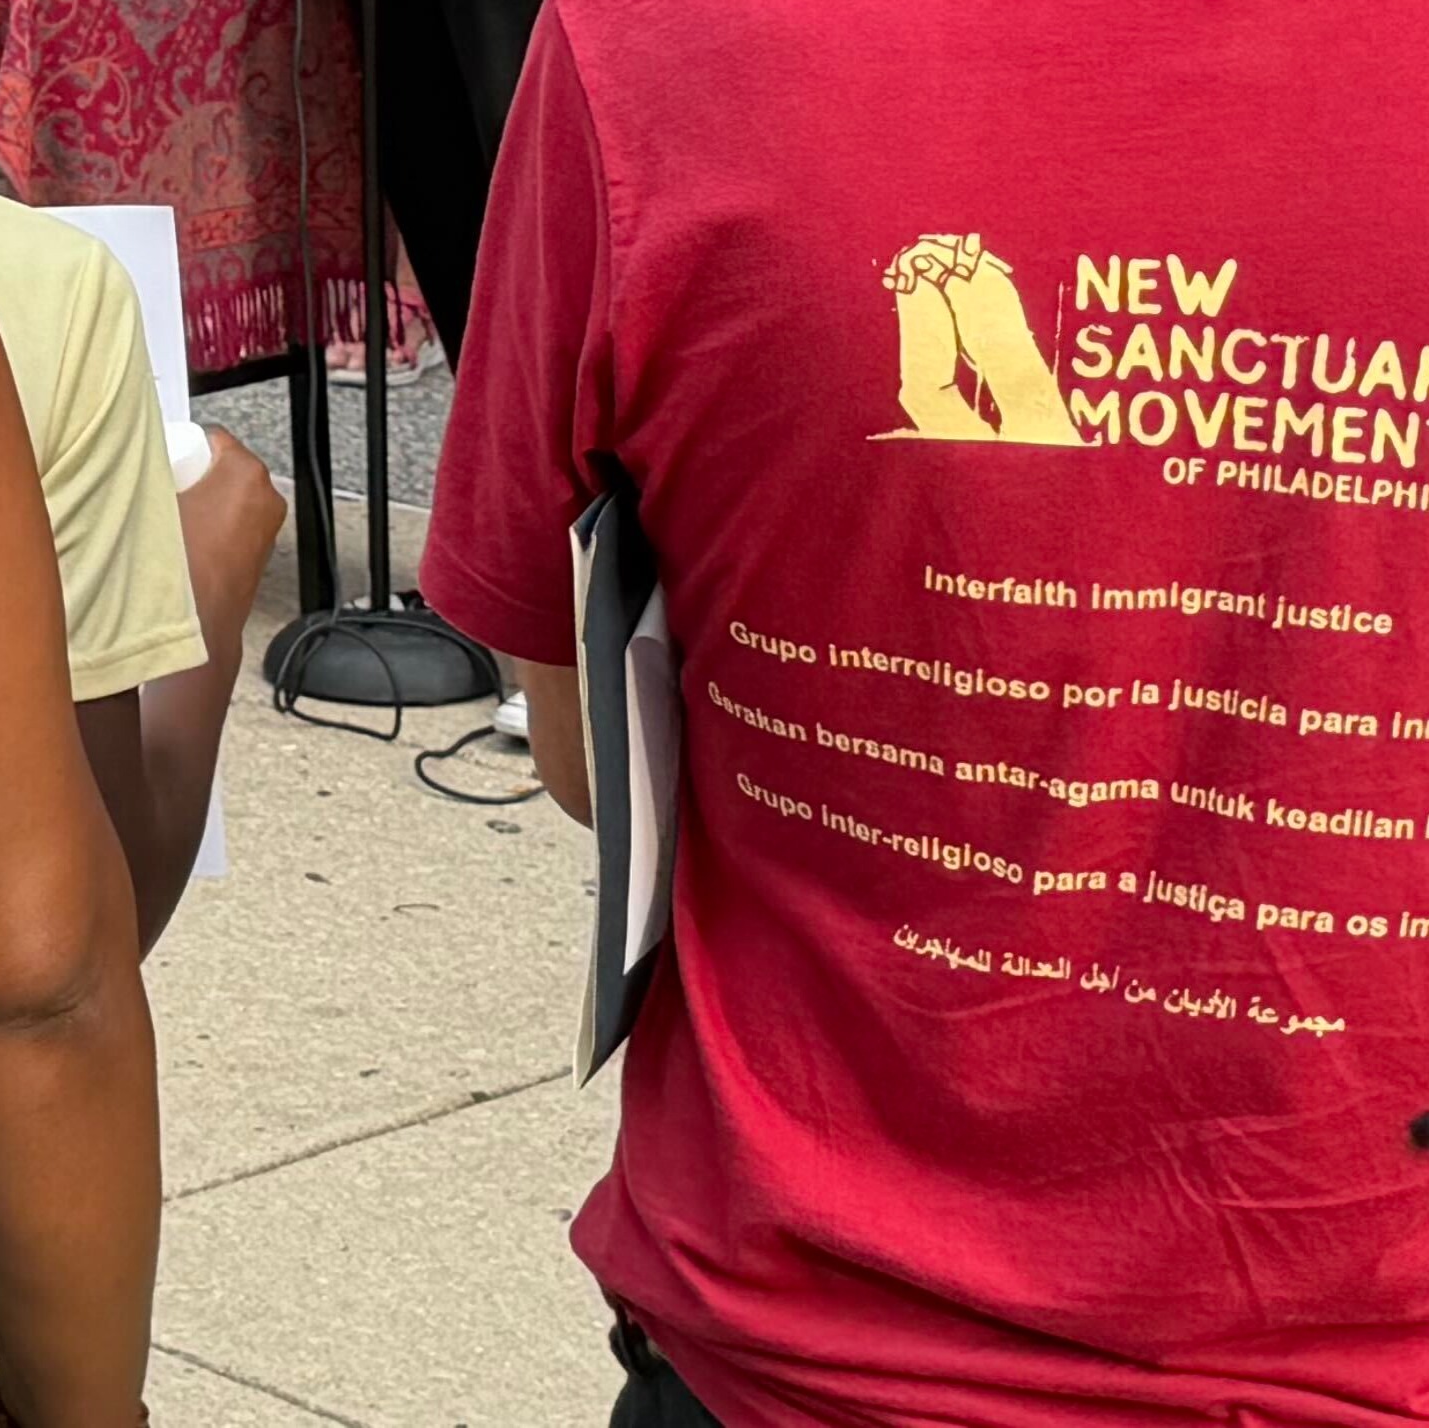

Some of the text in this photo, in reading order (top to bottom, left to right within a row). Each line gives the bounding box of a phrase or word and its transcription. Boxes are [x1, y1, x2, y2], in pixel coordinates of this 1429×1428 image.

[1076, 254, 1237, 316] NEW
[1071, 390, 1429, 468] MOVEMEN
[1163, 458, 1429, 510] OF PHILADELPHI
[925, 565, 1392, 635] Interfaith immigrant justice
[730, 622, 816, 663] Grupo
[829, 644, 1050, 700] interreligioso
[1063, 684, 1123, 708] por
[1131, 680, 1159, 704] la
[1168, 679, 1286, 726] justicia
[1299, 709, 1378, 736] para
[709, 682, 806, 741] Gerakan
[817, 723, 944, 775] bersama
[955, 762, 1159, 807] antar-agama
[1171, 782, 1254, 821] untuk
[1267, 799, 1414, 839] keadilan
[737, 773, 812, 819] Grupo
[822, 805, 1022, 883] inter-religioso
[1033, 871, 1106, 895] para
[1118, 872, 1136, 893] a
[1143, 871, 1244, 922] justiça
[1257, 904, 1334, 933] para
[1347, 915, 1388, 938] os
[1125, 979, 1156, 1004] من
